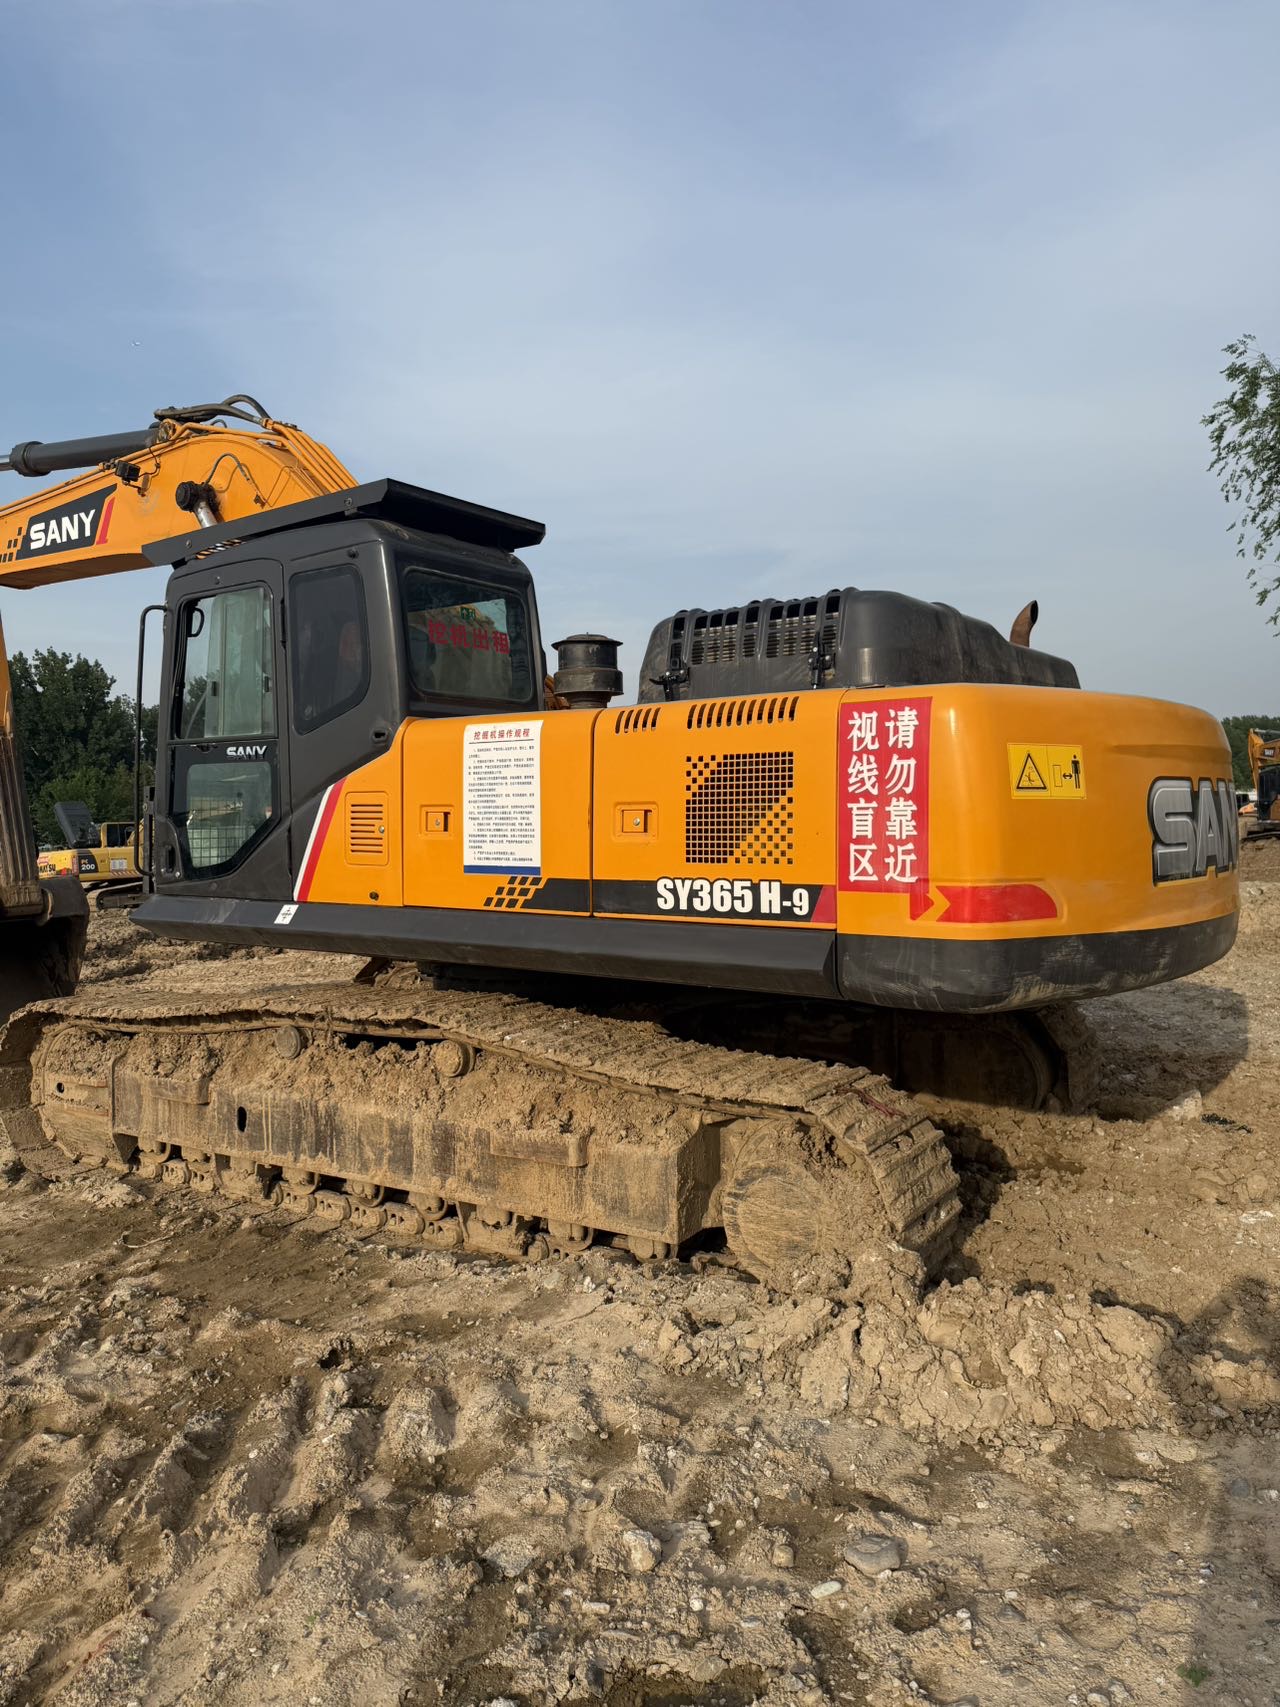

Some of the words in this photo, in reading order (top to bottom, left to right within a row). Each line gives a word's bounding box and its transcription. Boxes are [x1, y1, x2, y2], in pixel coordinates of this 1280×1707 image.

[30, 509, 95, 550] SANY
[428, 618, 510, 655] 挖机出租
[226, 745, 267, 758] SANY
[847, 710, 880, 882] 视线盲区
[884, 706, 919, 883] 请勿靠近
[81, 863, 96, 871] 200
[656, 877, 753, 913] SY365
